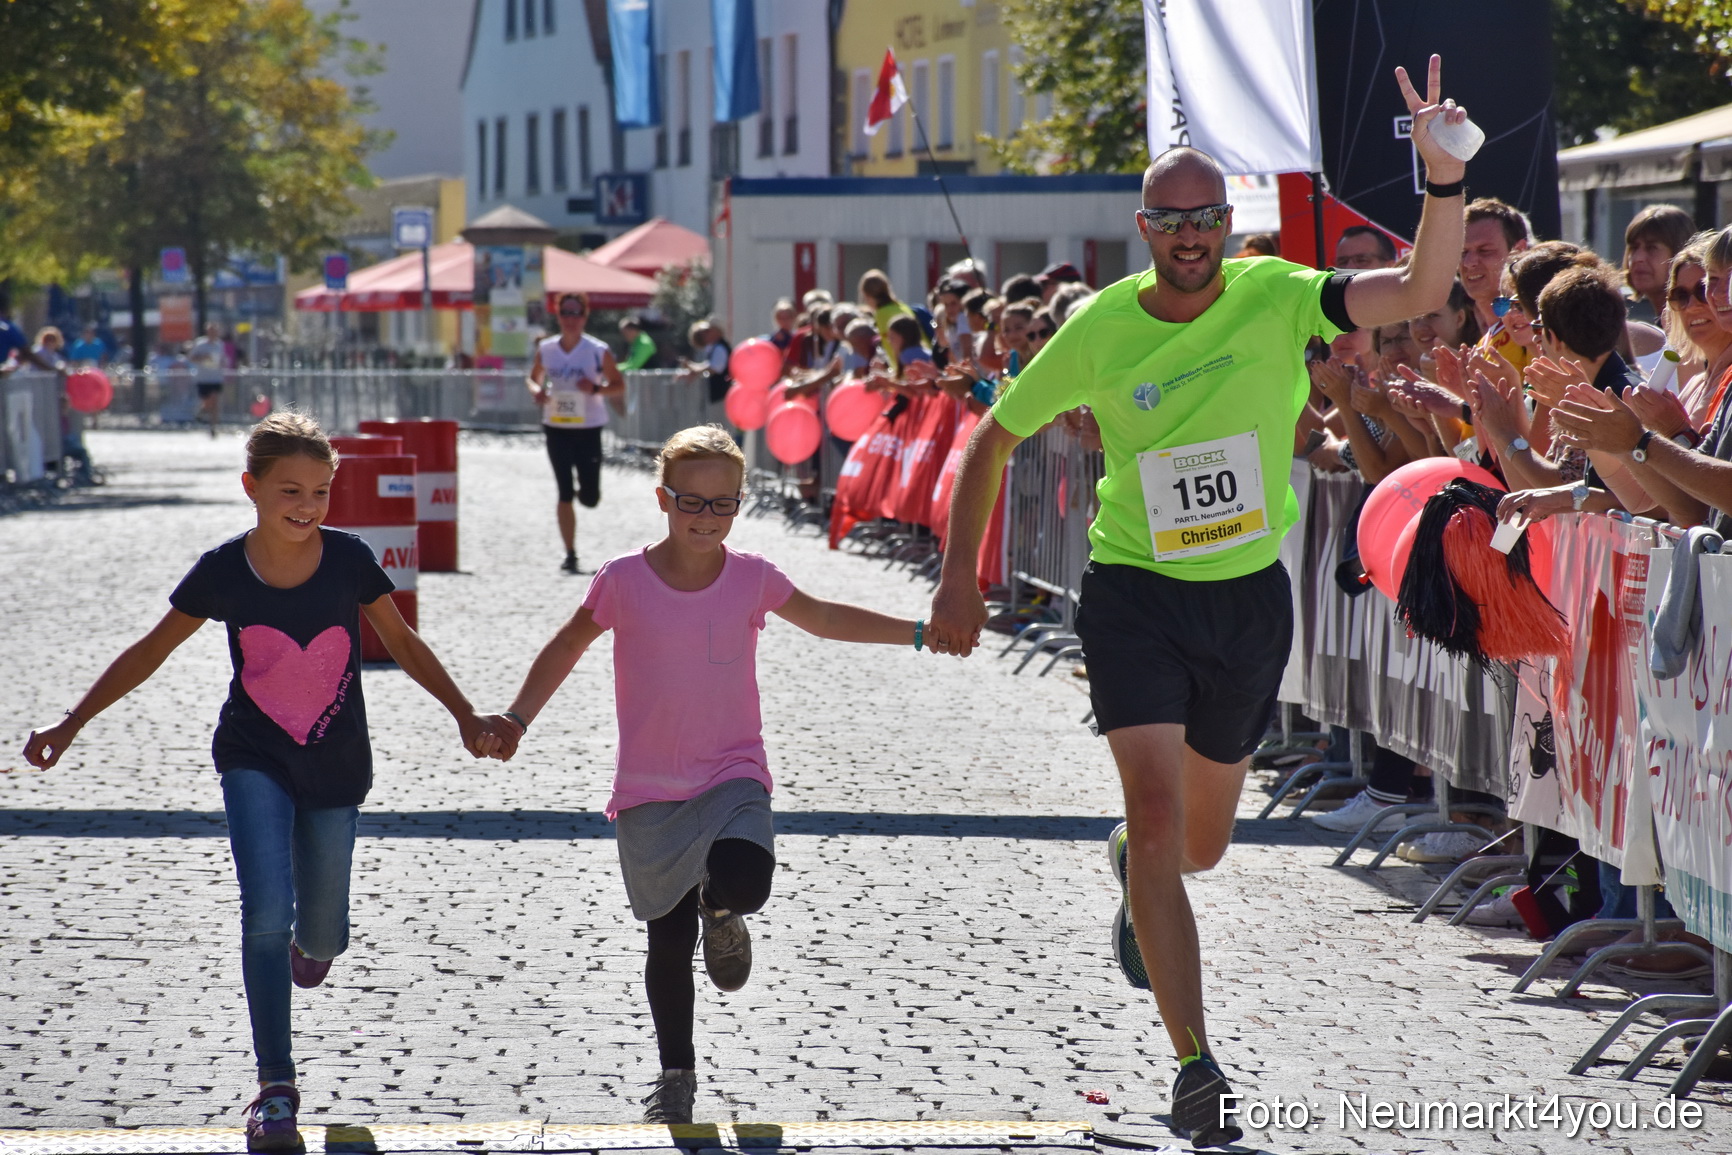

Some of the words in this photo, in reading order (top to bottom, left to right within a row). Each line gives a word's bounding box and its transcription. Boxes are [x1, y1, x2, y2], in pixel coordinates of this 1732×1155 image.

[1173, 449, 1227, 469] BOCK
[1172, 470, 1237, 511] 150
[1175, 514, 1200, 524] PARTL
[1201, 507, 1235, 520] Neumarkt
[1181, 521, 1242, 546] Christian
[313, 715, 331, 739] vida
[329, 703, 341, 716] es
[336, 671, 354, 703] chula
